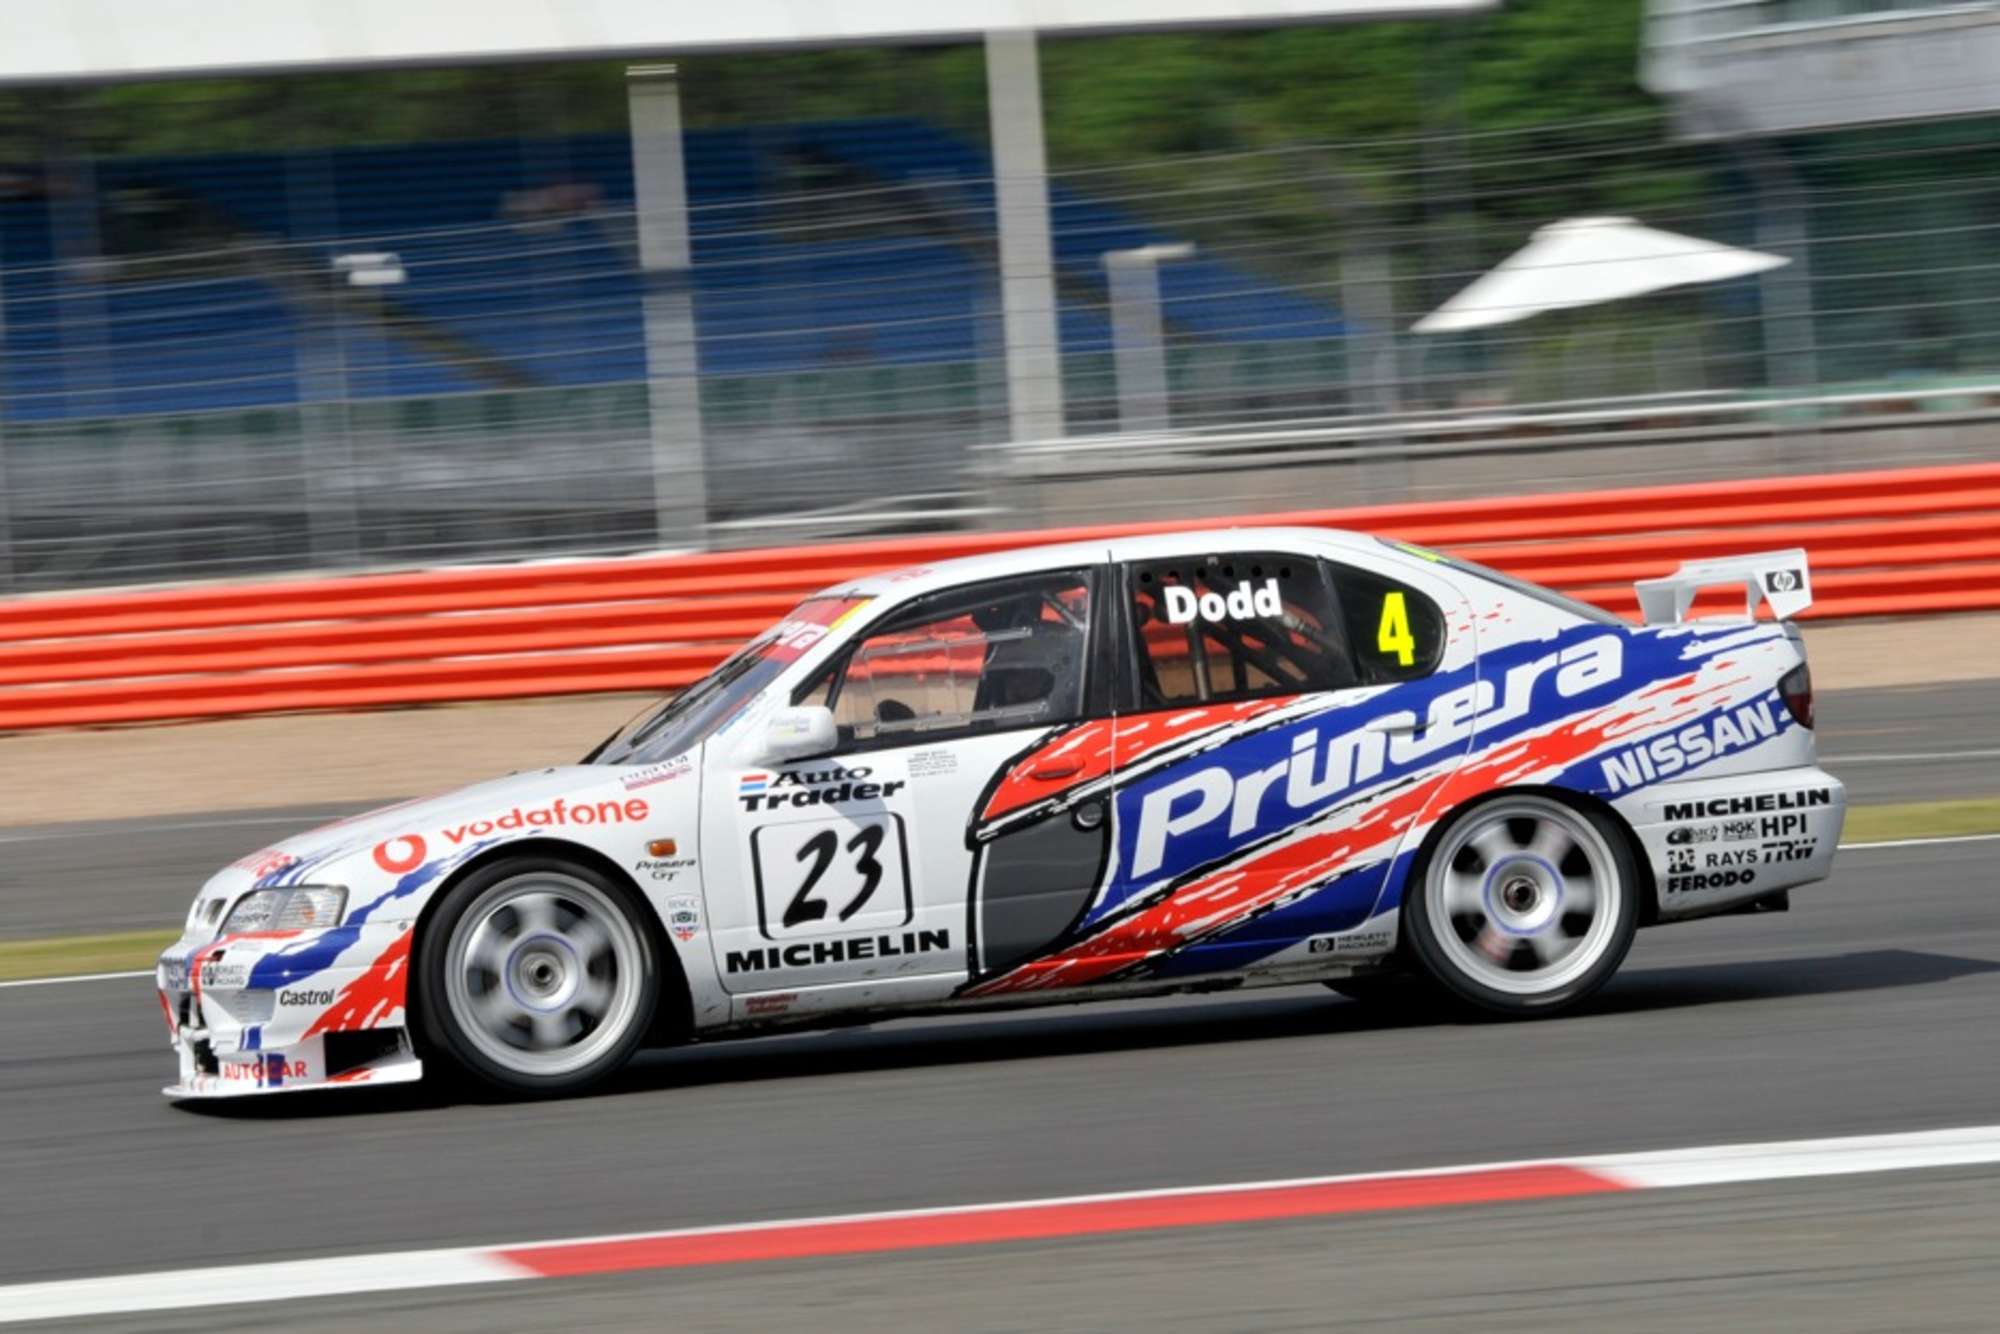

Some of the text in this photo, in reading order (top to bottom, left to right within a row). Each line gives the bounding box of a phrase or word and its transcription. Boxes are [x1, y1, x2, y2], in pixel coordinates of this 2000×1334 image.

[1164, 577, 1283, 625] Dodd
[1377, 592, 1415, 667] 4
[1131, 634, 1624, 880] Primera
[1600, 701, 1777, 794] NISSAN
[769, 766, 873, 788] Auto
[739, 780, 905, 813] Trader
[1664, 788, 1831, 822] MICHELIN
[442, 798, 649, 844] vodafone
[1723, 821, 1755, 836] NGK
[1761, 814, 1808, 839] HPI
[635, 860, 697, 871] Primera
[1706, 849, 1758, 868] RAYS
[782, 823, 885, 929] 23
[1667, 869, 1756, 894] FERODO
[727, 929, 950, 974] MICHELIN
[279, 988, 336, 1007] Castrol
[224, 1059, 308, 1081] AUTOCAR
